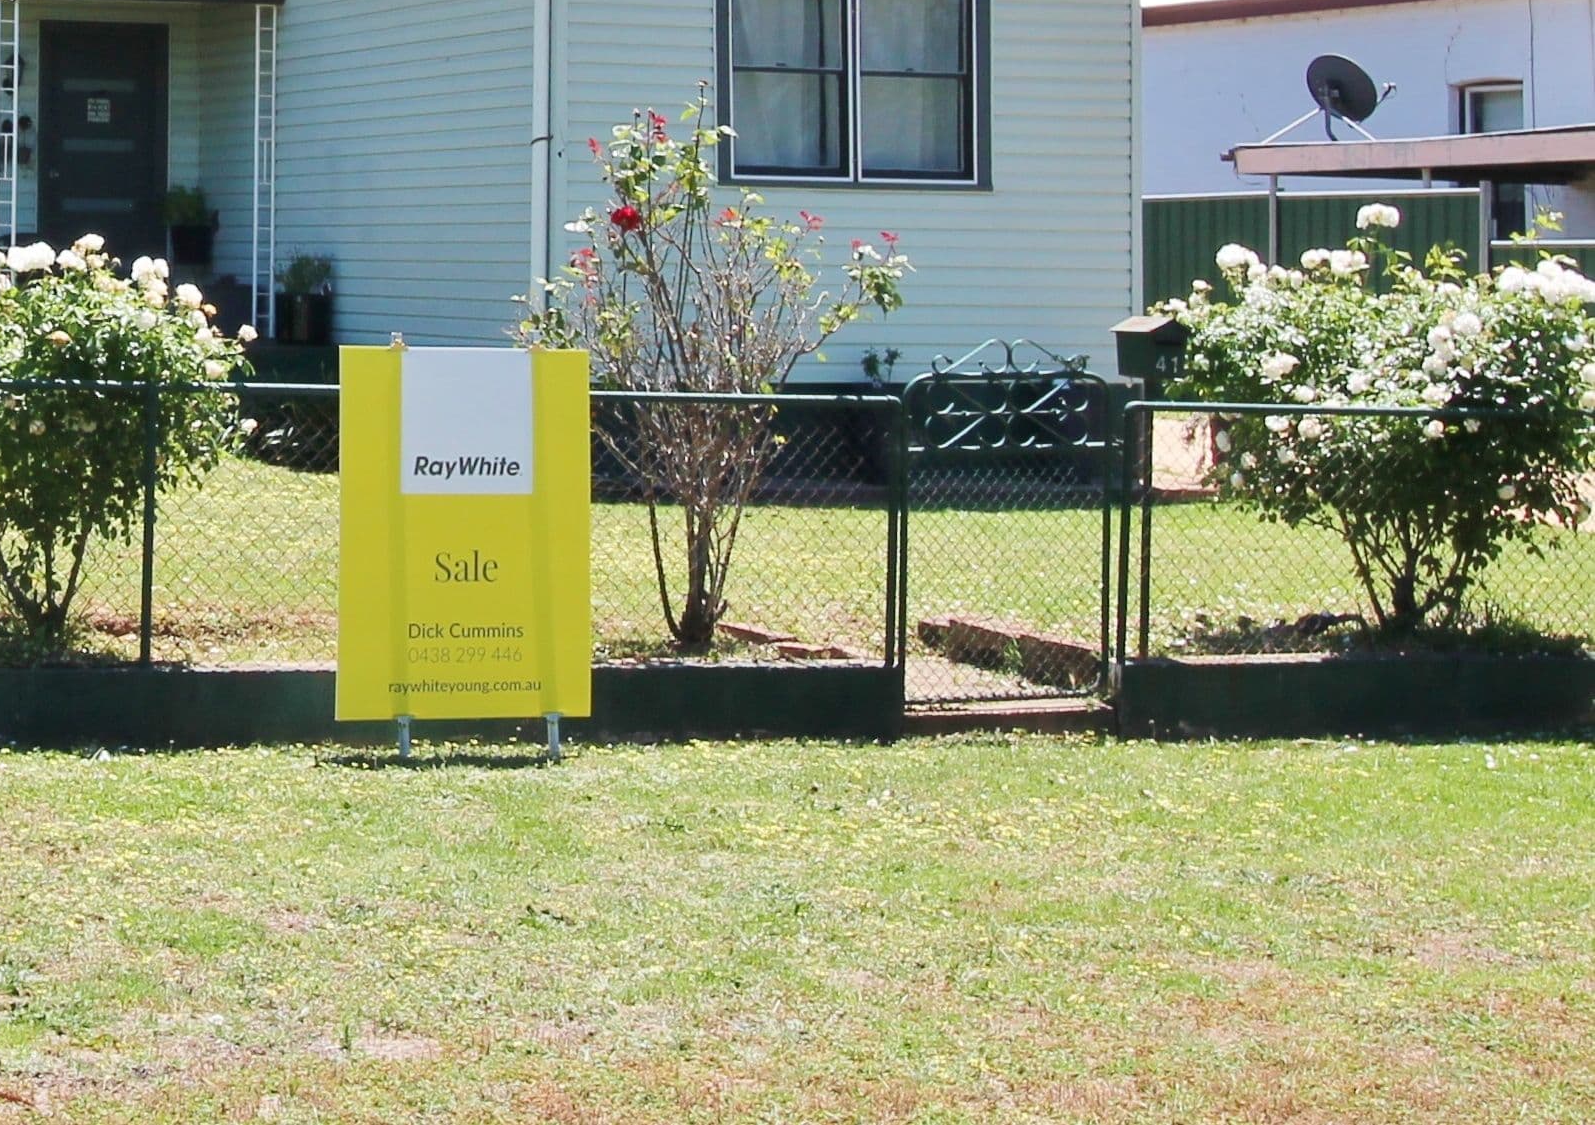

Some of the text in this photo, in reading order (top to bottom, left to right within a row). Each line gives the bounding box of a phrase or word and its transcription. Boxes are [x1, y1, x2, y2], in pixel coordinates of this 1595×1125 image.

[1155, 356, 1179, 374] 41
[434, 549, 498, 583] Sale
[408, 622, 525, 639] Dick Cummins
[408, 646, 523, 664] 0438 299 446
[388, 678, 542, 696] raywhiteyoung.com.au
